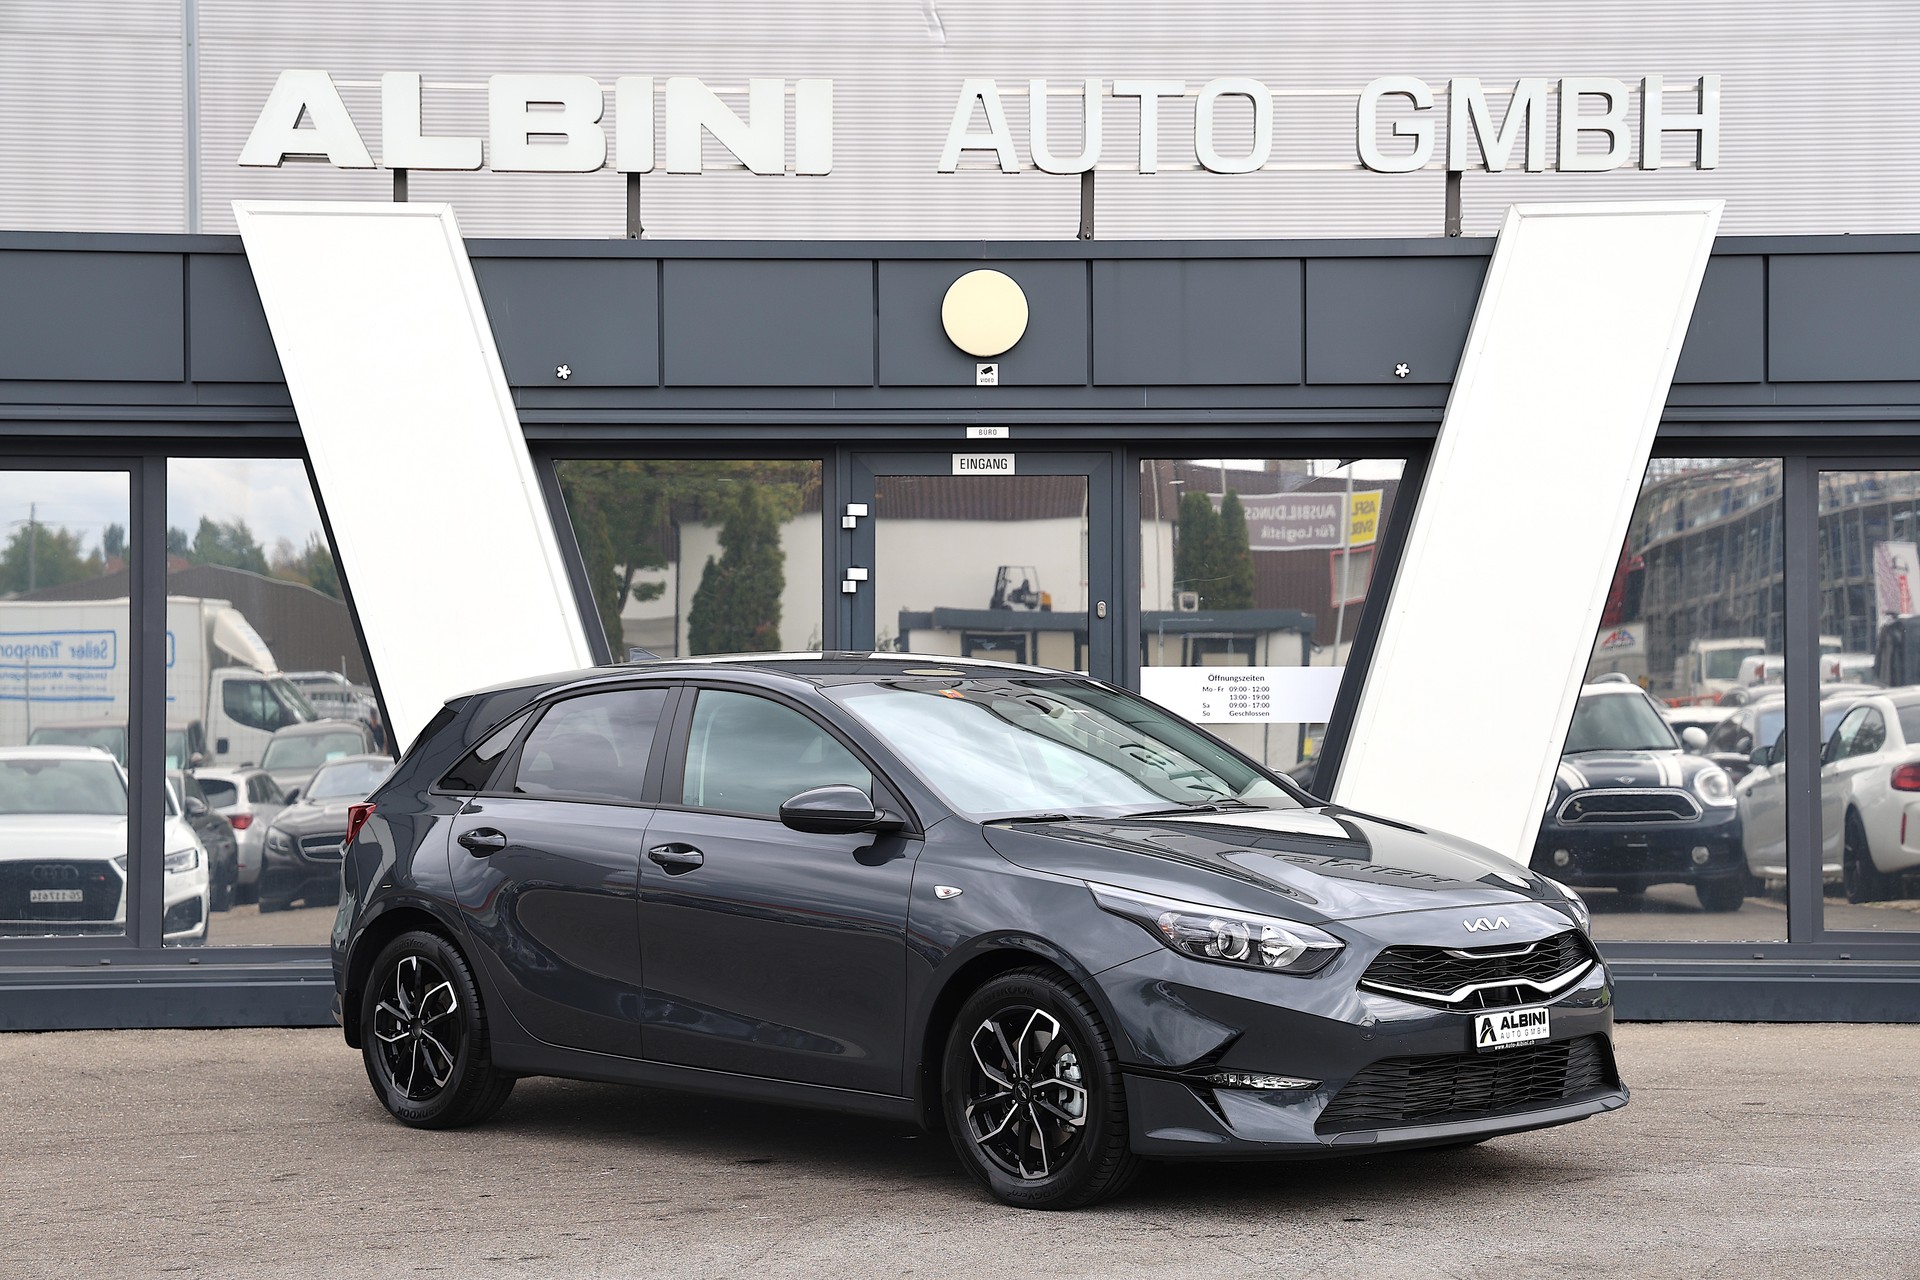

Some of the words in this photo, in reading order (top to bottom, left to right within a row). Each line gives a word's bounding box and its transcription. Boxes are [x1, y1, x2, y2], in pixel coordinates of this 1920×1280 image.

[237, 69, 833, 176] ALBINI
[937, 77, 1273, 174] AUTO
[1356, 75, 1720, 173] GMBH
[978, 428, 997, 436] BÜRO
[960, 458, 1008, 470] EINGANG
[1208, 673, 1265, 683] Öffnungszeiten
[1462, 916, 1510, 933] KIA
[1501, 1011, 1546, 1030] ALBINI
[1501, 1030, 1521, 1039] AUTO
[1525, 1027, 1547, 1036] GMBH
